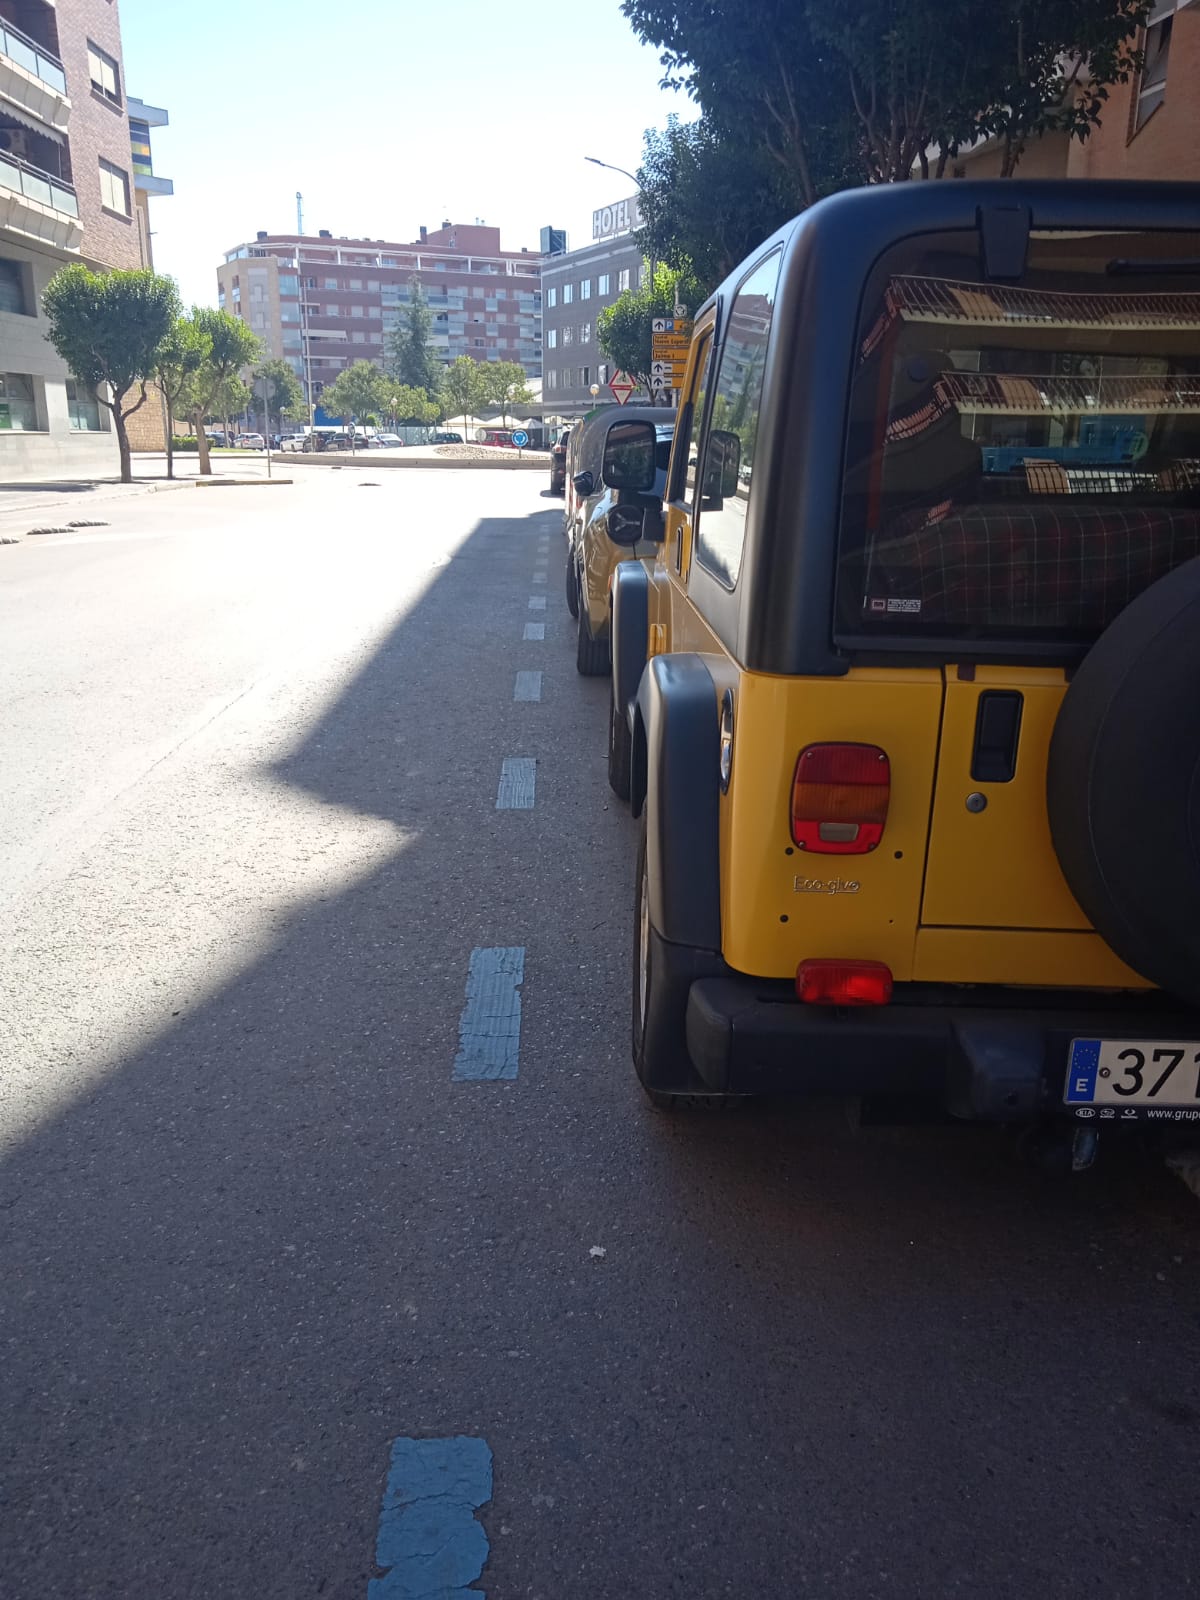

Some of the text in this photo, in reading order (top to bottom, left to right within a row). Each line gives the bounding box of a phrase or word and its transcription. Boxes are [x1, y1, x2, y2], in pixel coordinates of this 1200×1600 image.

[593, 200, 631, 237] HOTEL
[1075, 1078, 1089, 1092] E
[1147, 1109, 1200, 1121] www.grup
